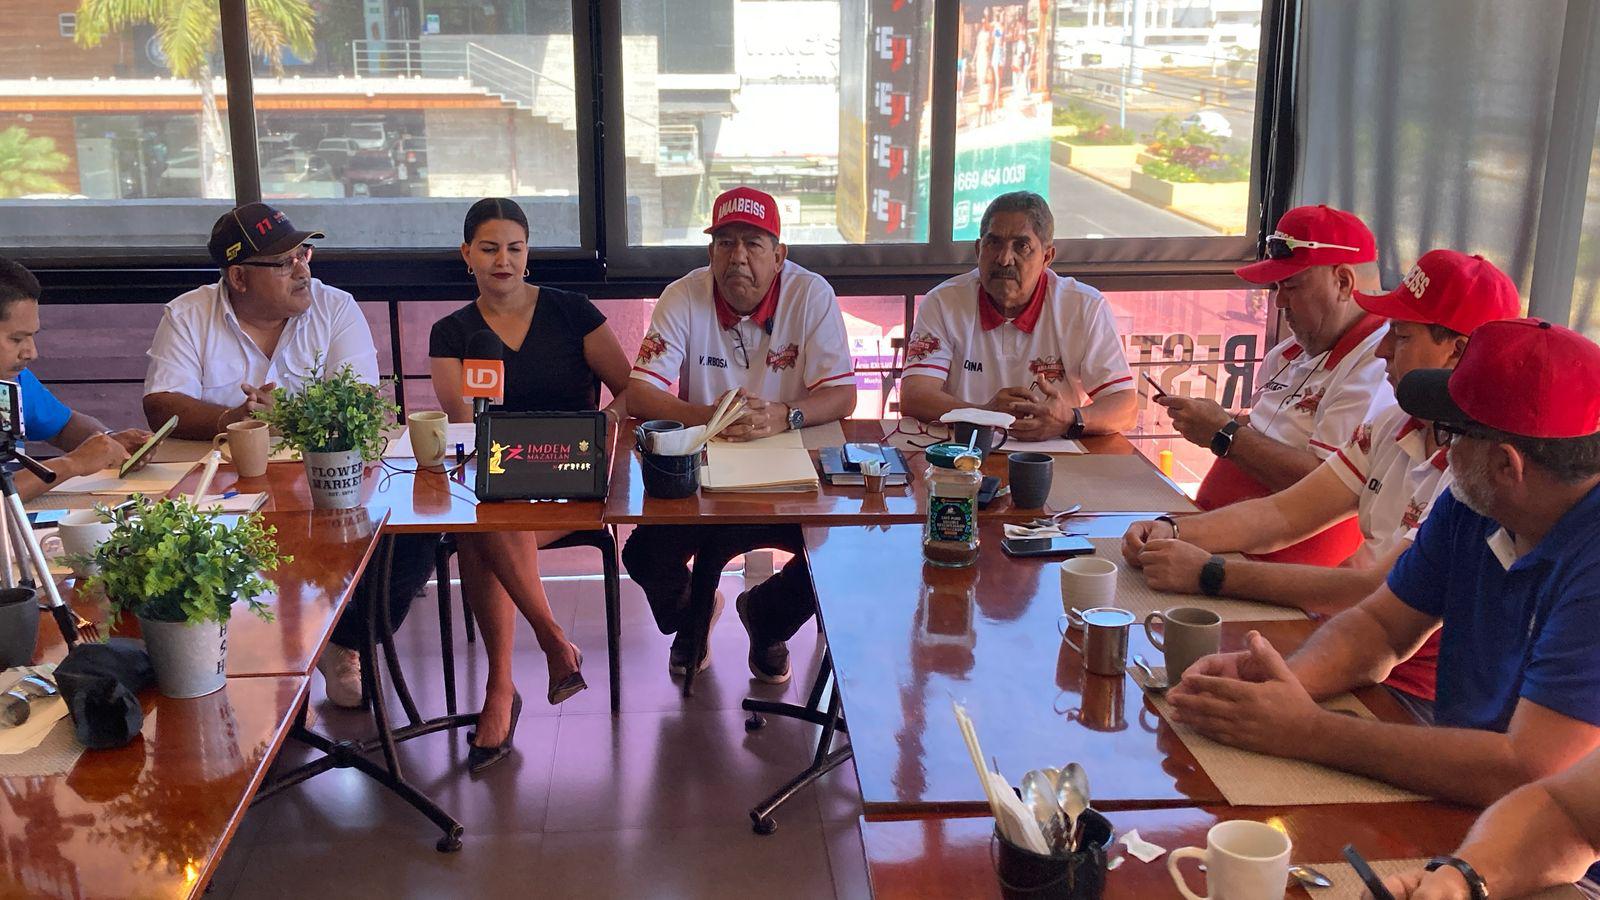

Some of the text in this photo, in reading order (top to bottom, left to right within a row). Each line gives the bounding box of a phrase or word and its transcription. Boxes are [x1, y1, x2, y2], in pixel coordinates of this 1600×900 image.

[957, 171, 979, 191] 669
[255, 217, 273, 236] 11
[527, 443, 571, 454] IMDEM
